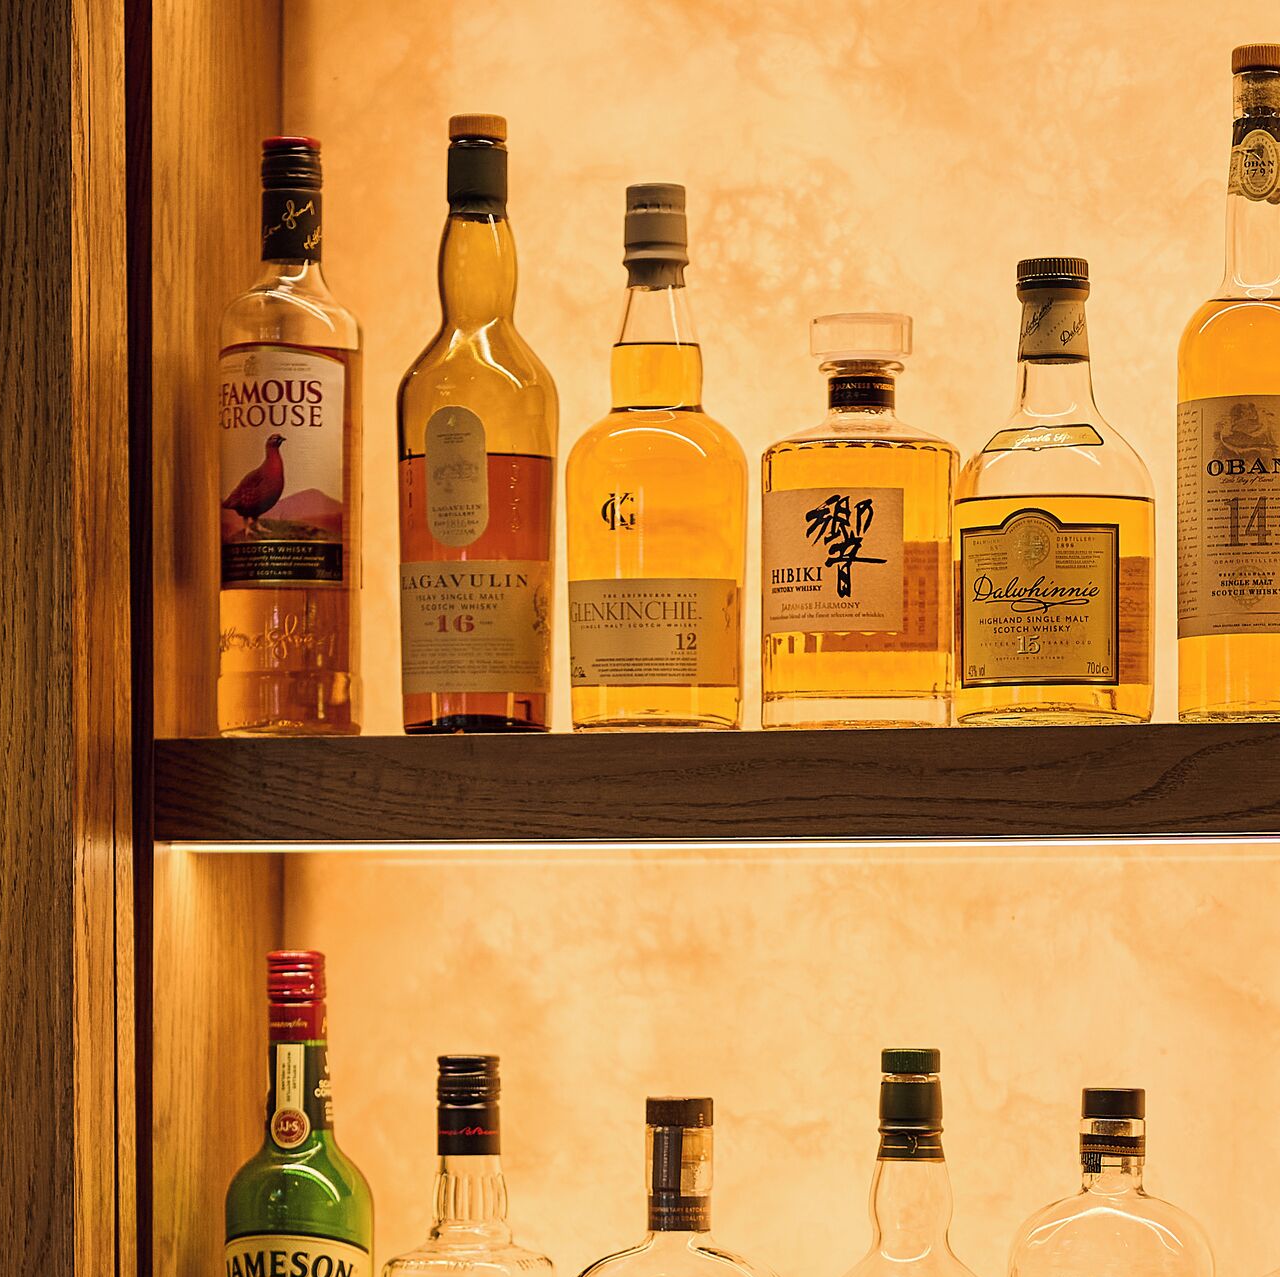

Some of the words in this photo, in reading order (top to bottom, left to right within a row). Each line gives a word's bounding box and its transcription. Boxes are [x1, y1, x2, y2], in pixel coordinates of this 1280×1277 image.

[222, 379, 323, 405] FAMOUS
[221, 404, 323, 430] GROUSE
[1223, 496, 1272, 547] 14
[401, 573, 529, 591] LAGAVULIN
[771, 566, 823, 584] HIBIKI
[1251, 578, 1274, 587] MALT
[440, 592, 474, 601] SINGLE
[479, 592, 505, 601] MALT
[972, 573, 1101, 602] Dalwhinnie
[1211, 588, 1246, 598] SCOTCH
[420, 602, 456, 612] SCOTCH
[460, 602, 498, 611] WHISKY
[435, 614, 476, 634] 16
[979, 616, 1023, 625] HIGHLAND
[1026, 615, 1061, 624] SINGLE
[993, 625, 1029, 634] SCOTCH
[1032, 624, 1071, 633] WHISKY
[675, 632, 697, 650] 12
[1016, 634, 1041, 655] 15
